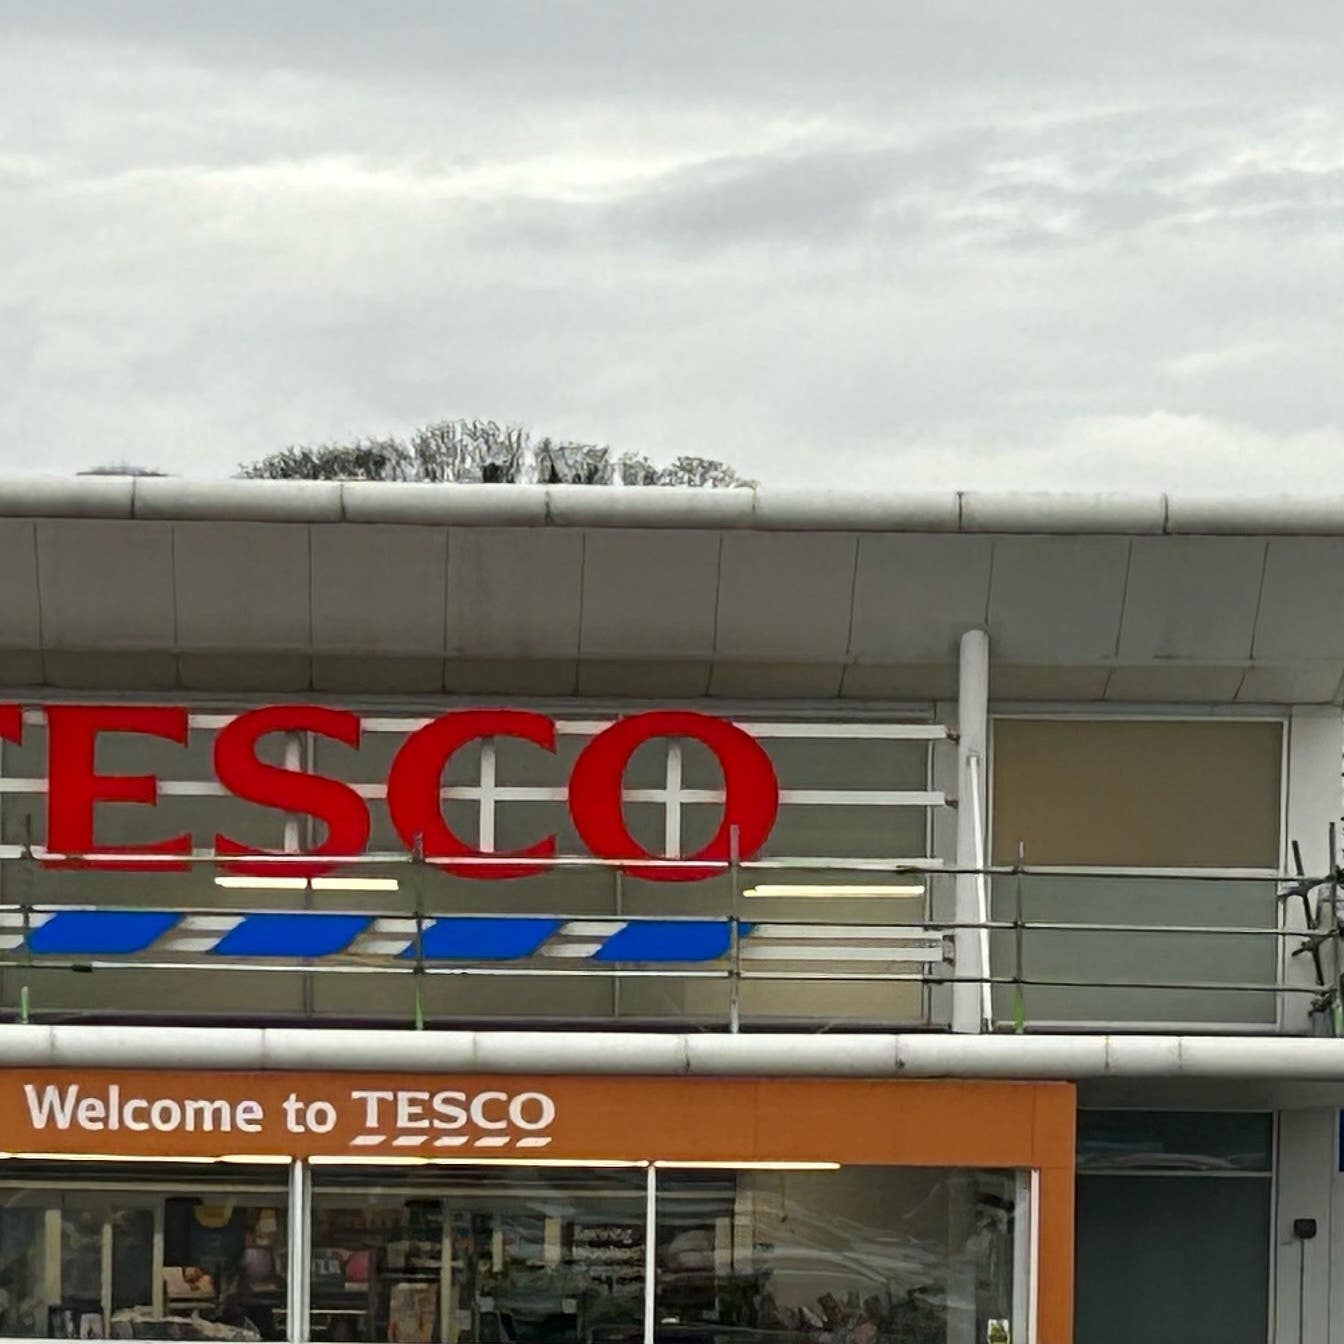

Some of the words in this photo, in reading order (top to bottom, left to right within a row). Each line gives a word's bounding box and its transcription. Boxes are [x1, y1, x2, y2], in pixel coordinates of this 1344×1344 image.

[23, 1083, 264, 1134] Welcome
[282, 1092, 337, 1135] to
[350, 1090, 556, 1131] TESCO
